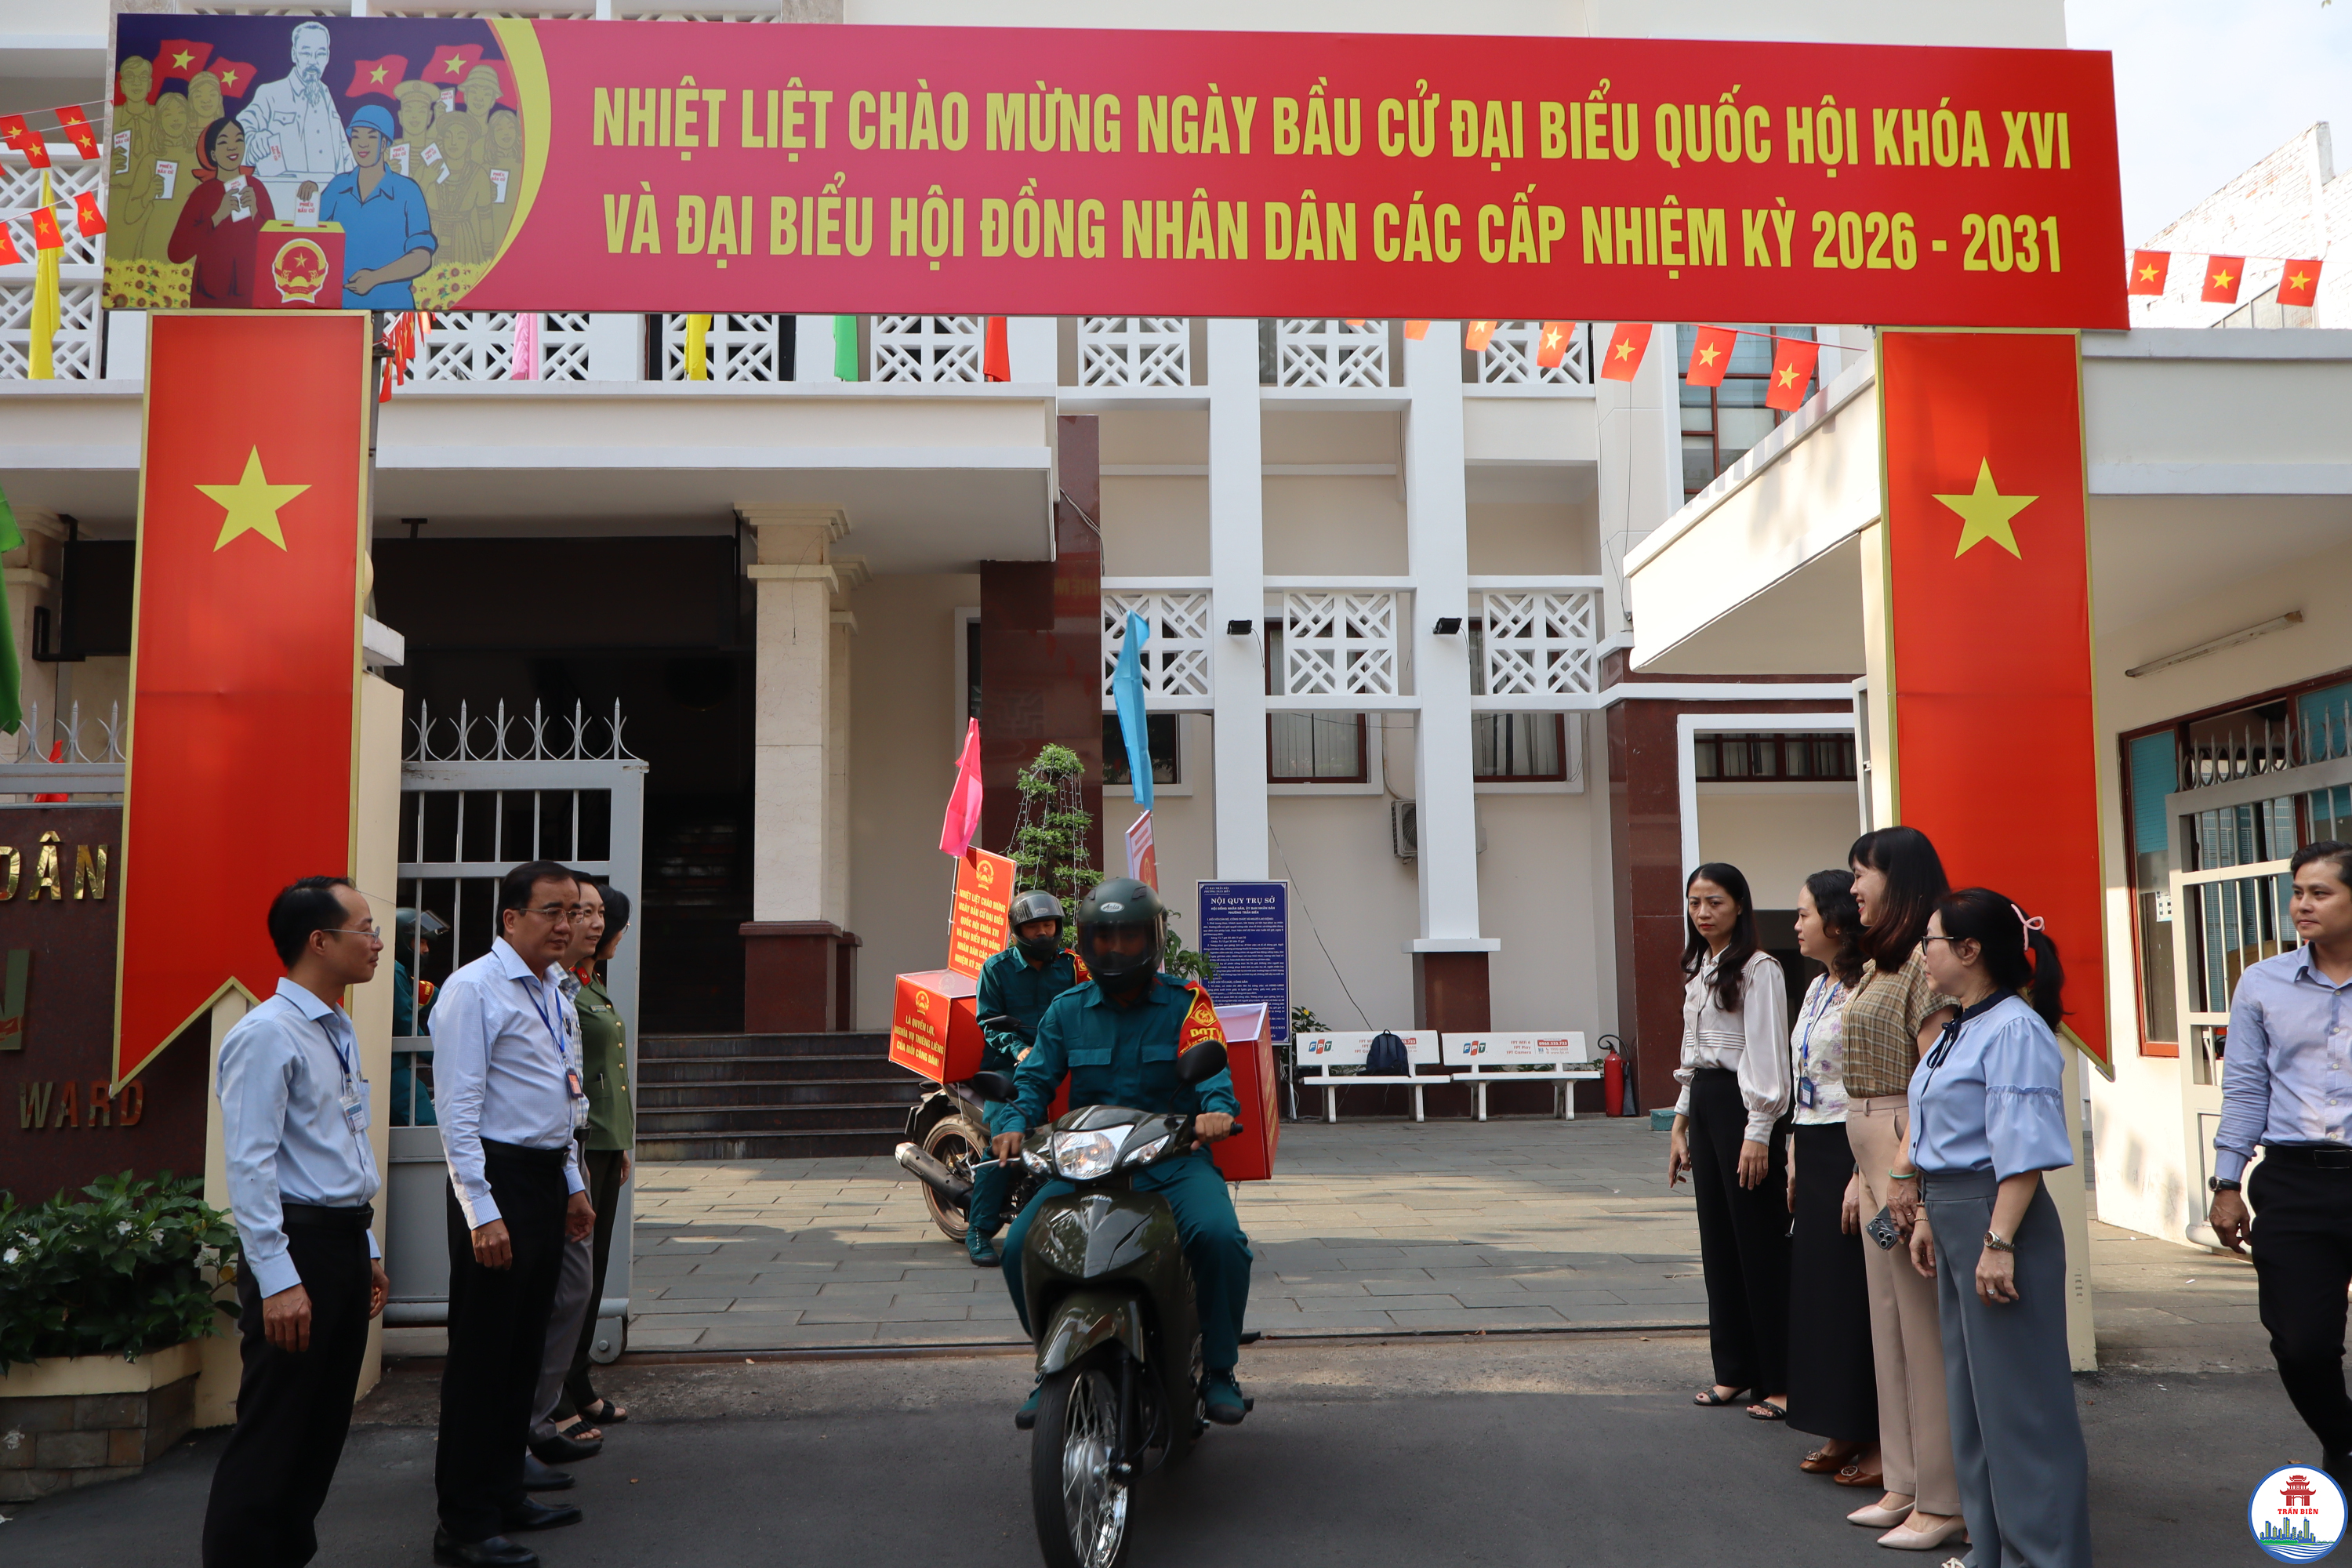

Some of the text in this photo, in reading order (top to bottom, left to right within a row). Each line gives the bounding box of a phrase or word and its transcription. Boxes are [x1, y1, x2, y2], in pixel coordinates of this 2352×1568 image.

[593, 75, 2071, 178] NHIỆT LIỆT CHÀO MỪNG NGÀY BẦU CỬ ĐẠI BIỂU QUỐC HỘI KHÓA XVI
[604, 171, 2061, 280] VÀ ĐẠI BIỂU HỘI ĐỒNG NHÂN DÂN CÁC CẤP NHIỆM KỲ 2026 - 2031
[0, 829, 108, 902] DÂN
[959, 888, 971, 902] NHIỆT
[971, 893, 981, 905] LIỆT
[981, 897, 993, 908] CHÀO
[1210, 896, 1225, 906] NỘI
[1264, 895, 1276, 904] SỞ
[958, 902, 970, 913] NGÀY
[960, 916, 972, 927] QUỐC
[1308, 1039, 1332, 1054] FPT
[1463, 1040, 1486, 1055] FPT
[20, 1080, 144, 1129] WARD
